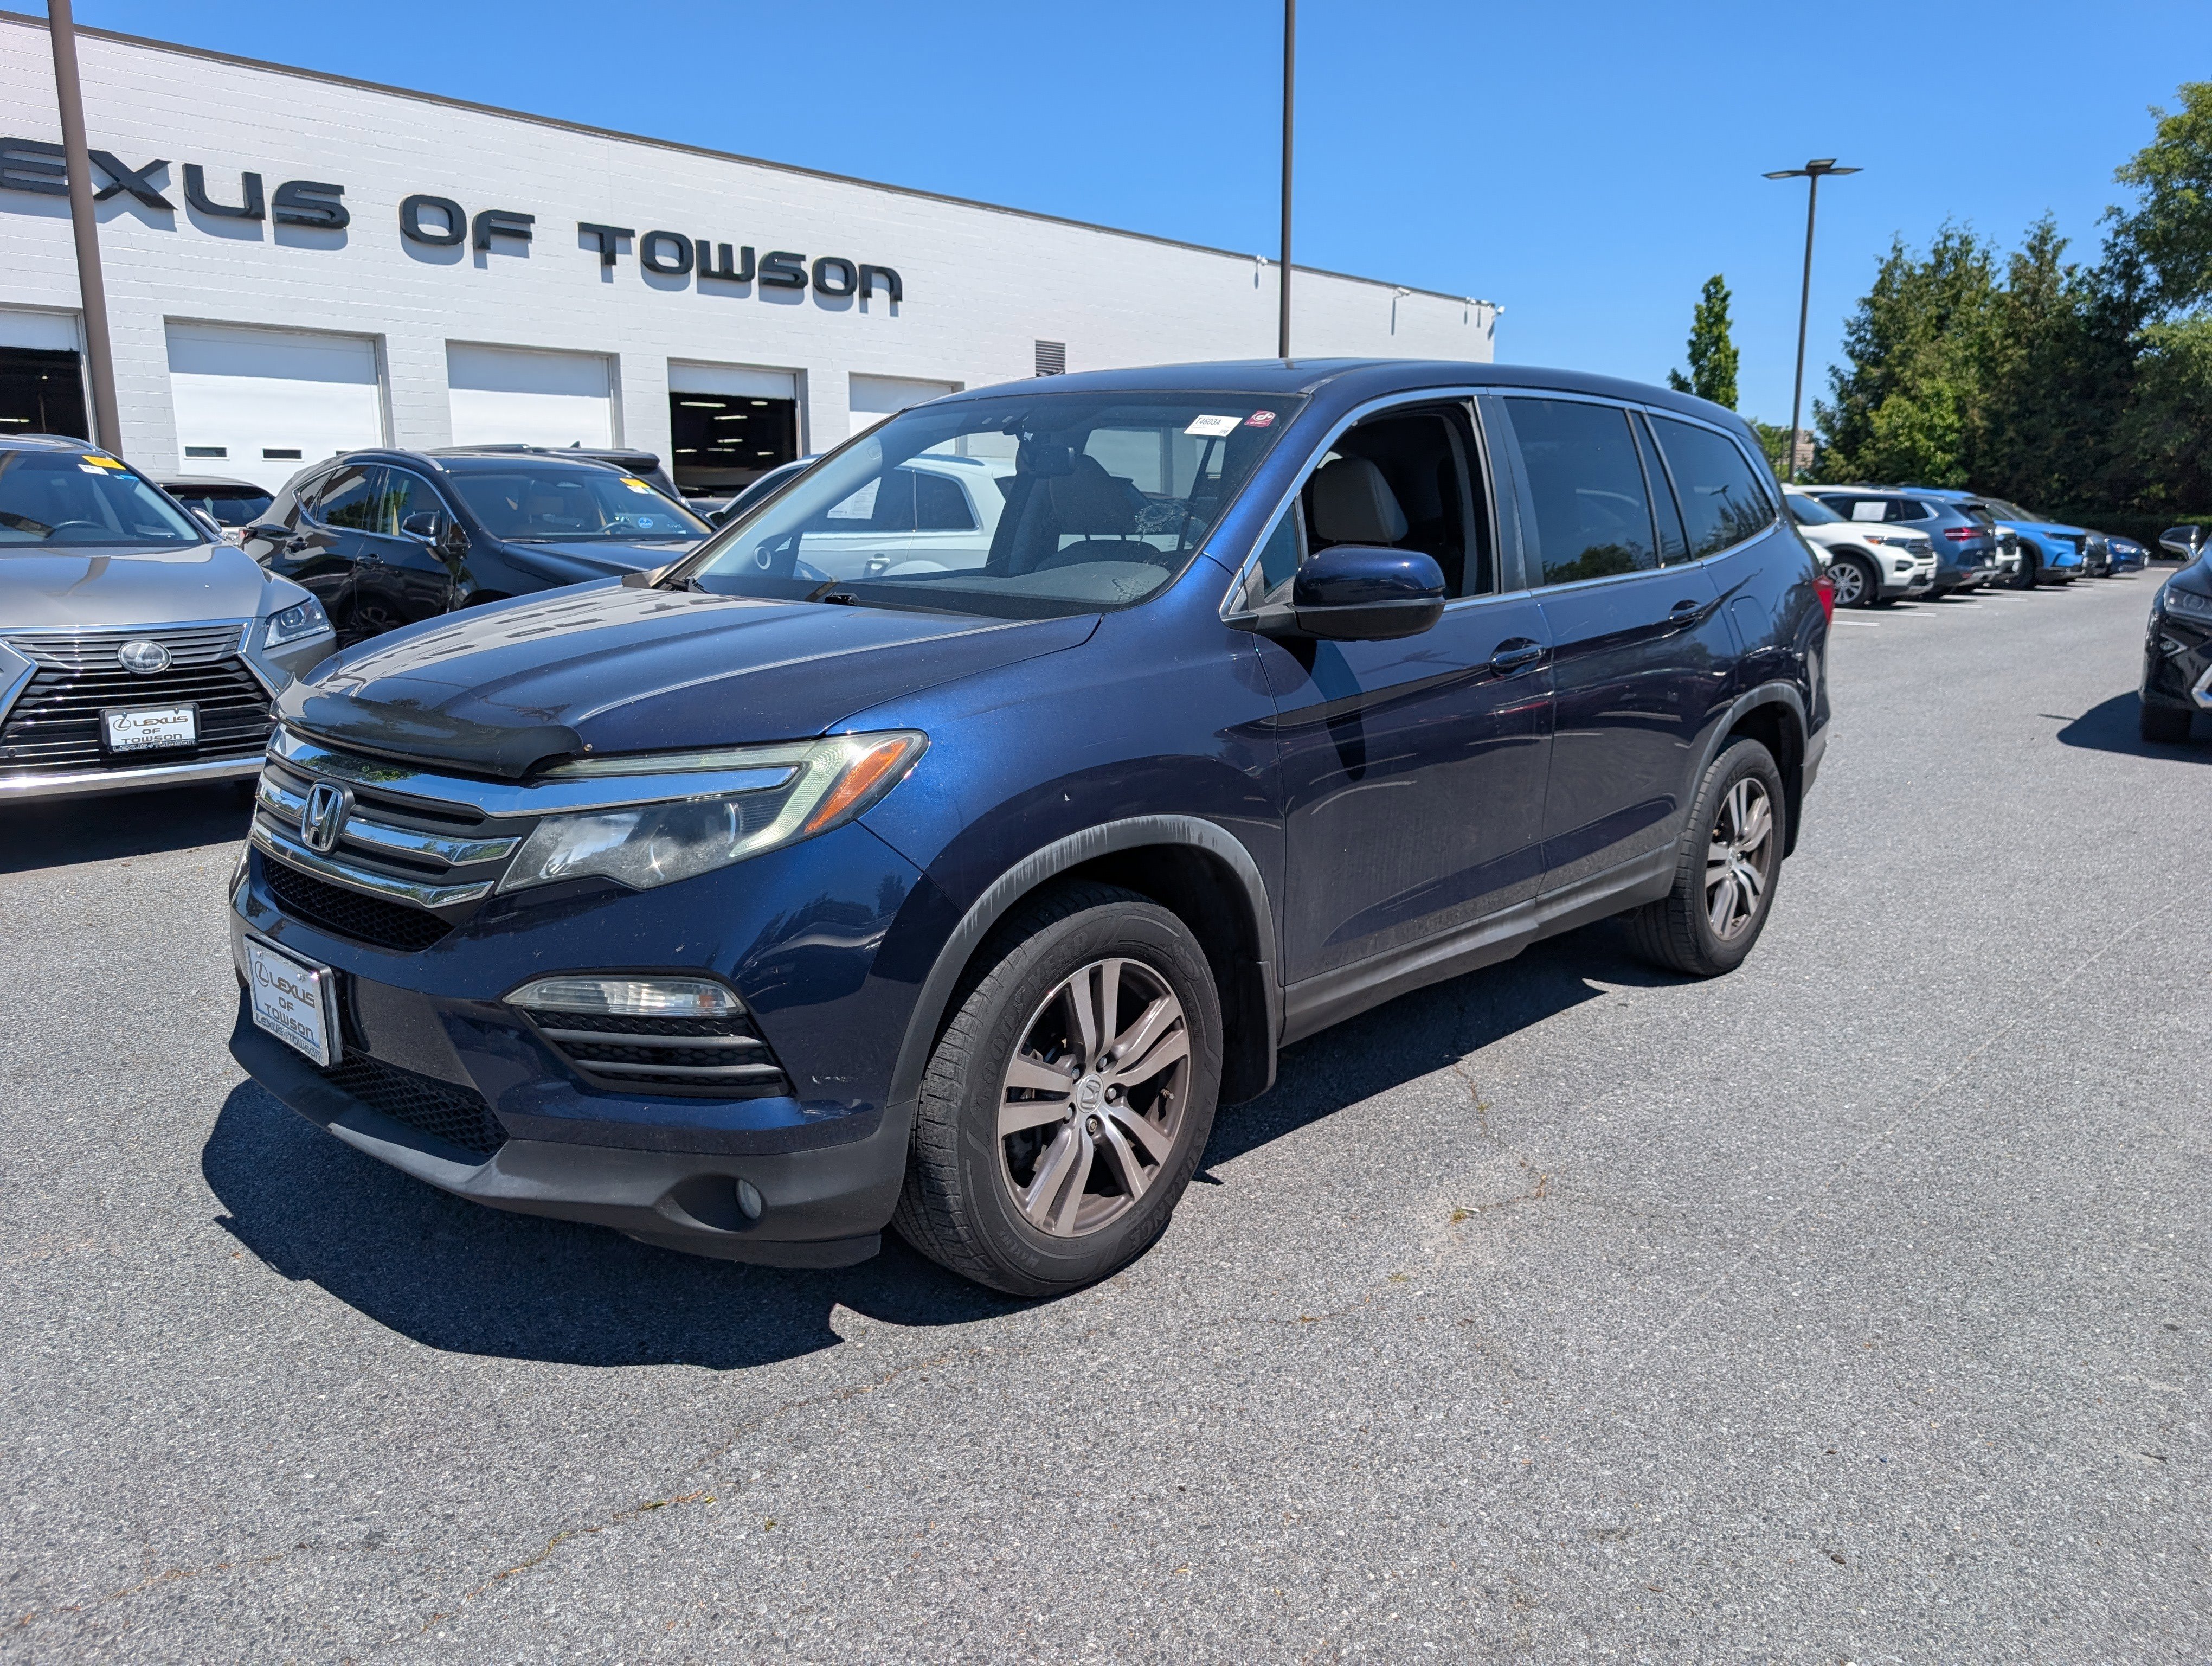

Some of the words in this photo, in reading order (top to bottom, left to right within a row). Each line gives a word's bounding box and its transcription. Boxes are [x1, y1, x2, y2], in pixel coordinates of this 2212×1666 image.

[0, 137, 350, 230] EXUS
[399, 193, 535, 251] OF
[577, 221, 903, 302] TOWSON
[1195, 417, 1221, 426] T4603A
[133, 715, 189, 727] LEXUS
[121, 733, 183, 744] TOWSON
[113, 744, 147, 752] LEXUS
[269, 971, 316, 1009] LEXUS
[278, 996, 294, 1012] OF
[264, 1002, 314, 1041] TOWSON
[256, 1013, 284, 1036] LEXUS
[287, 1031, 323, 1062] TOWSON
